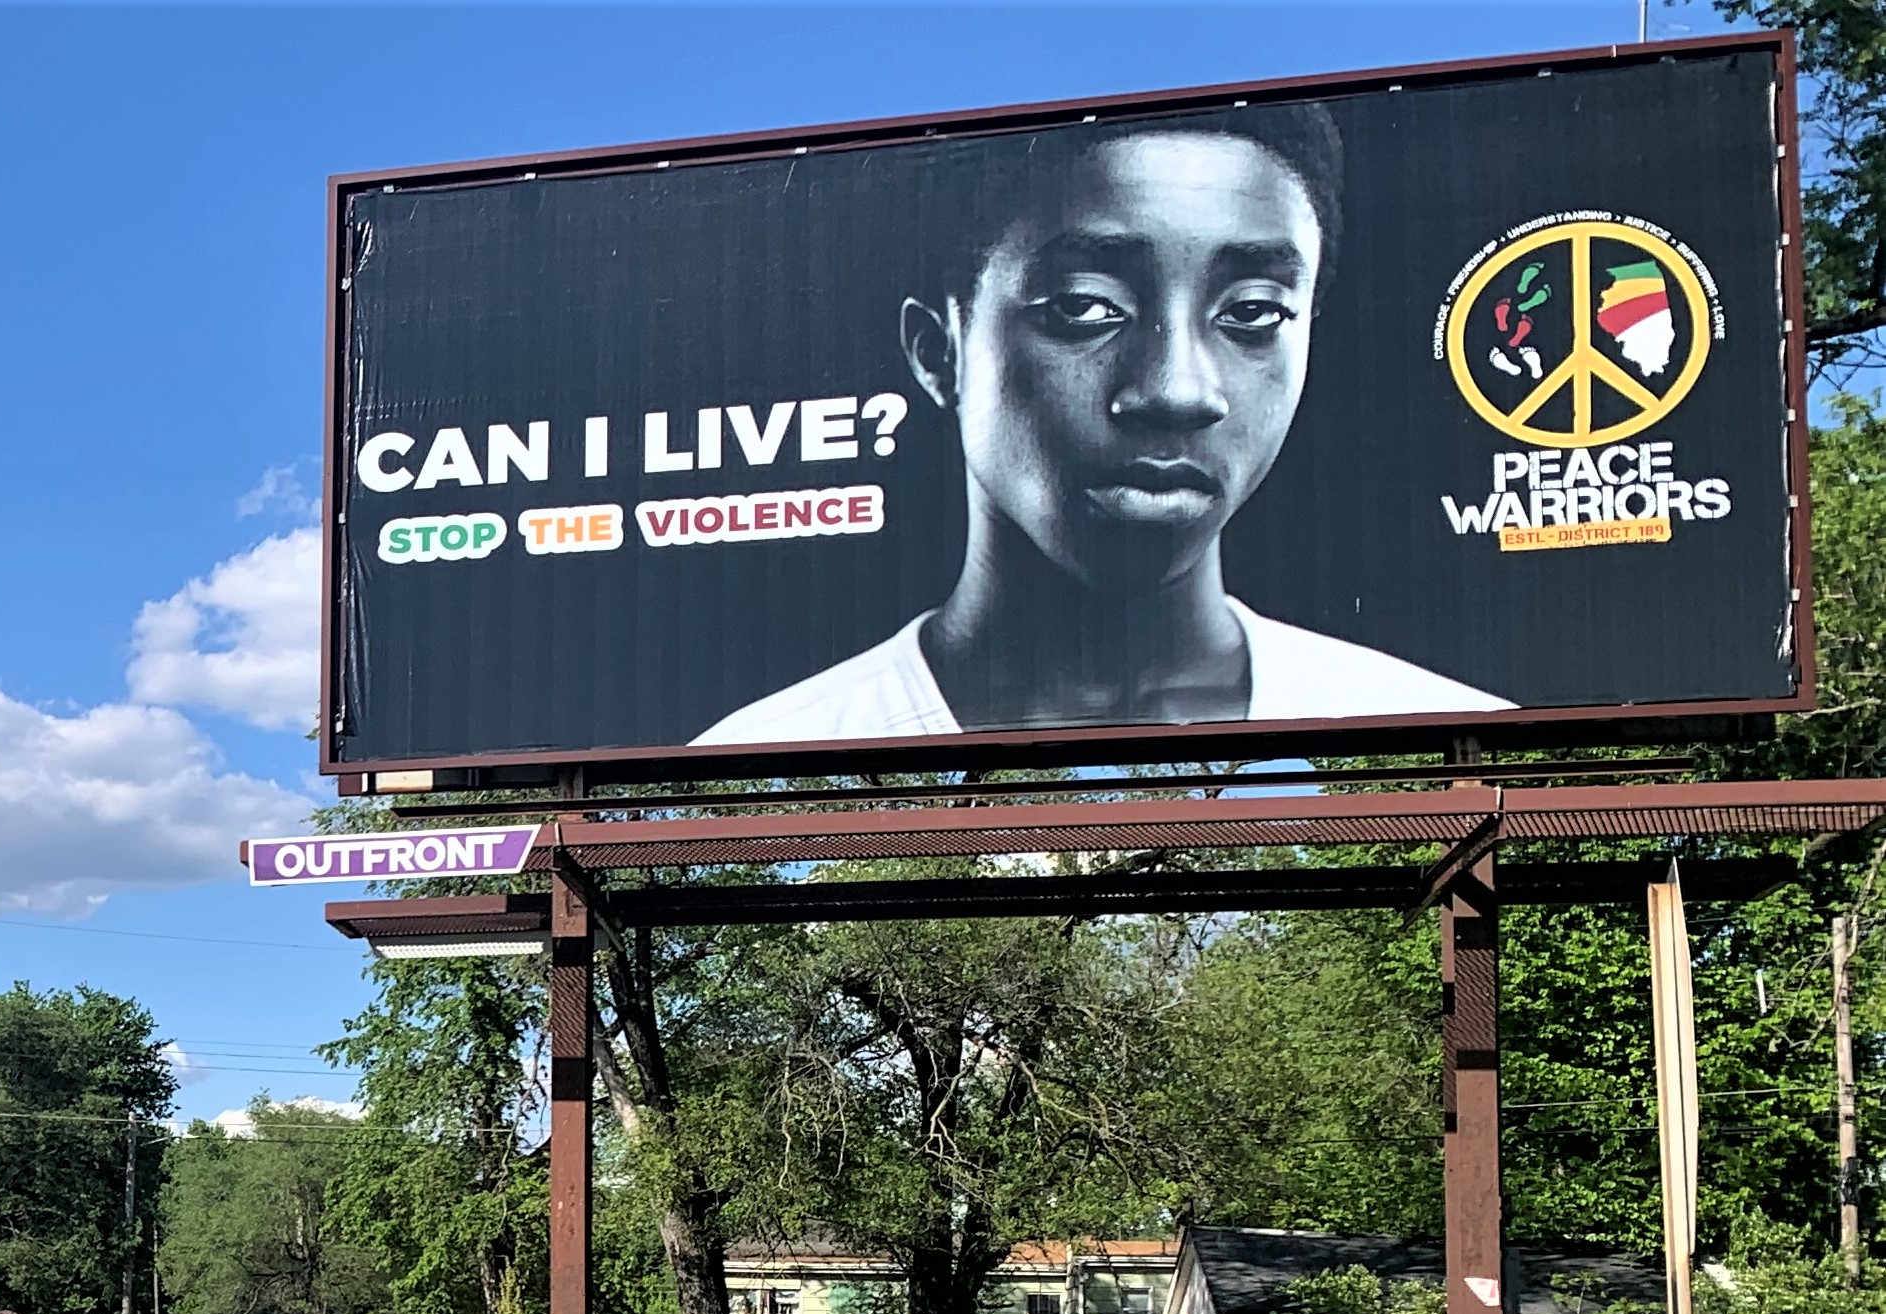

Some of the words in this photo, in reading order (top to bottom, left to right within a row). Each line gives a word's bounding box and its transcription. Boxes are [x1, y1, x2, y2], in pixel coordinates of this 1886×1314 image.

[1434, 303, 1450, 360] COURAGE
[1447, 239, 1498, 296] FRIENDSHIP
[1506, 209, 1612, 239] UNDERSTANDING
[1623, 215, 1671, 241] JUSTICE
[1676, 241, 1719, 298] SUFFERING
[1713, 305, 1725, 340] LOVE
[357, 420, 549, 492] CAN
[585, 416, 608, 477] I
[644, 393, 908, 474] LIVE?
[1493, 442, 1673, 492] PEACE
[388, 523, 497, 553] STOP
[529, 514, 613, 545] THE
[646, 495, 873, 537] VIOLENCE
[1441, 478, 1732, 534] WARRIORS
[1505, 532, 1545, 545] ESTL
[1558, 526, 1631, 542] DISTRICT
[1639, 525, 1664, 536] 189
[274, 834, 506, 877] OUTFRONT
